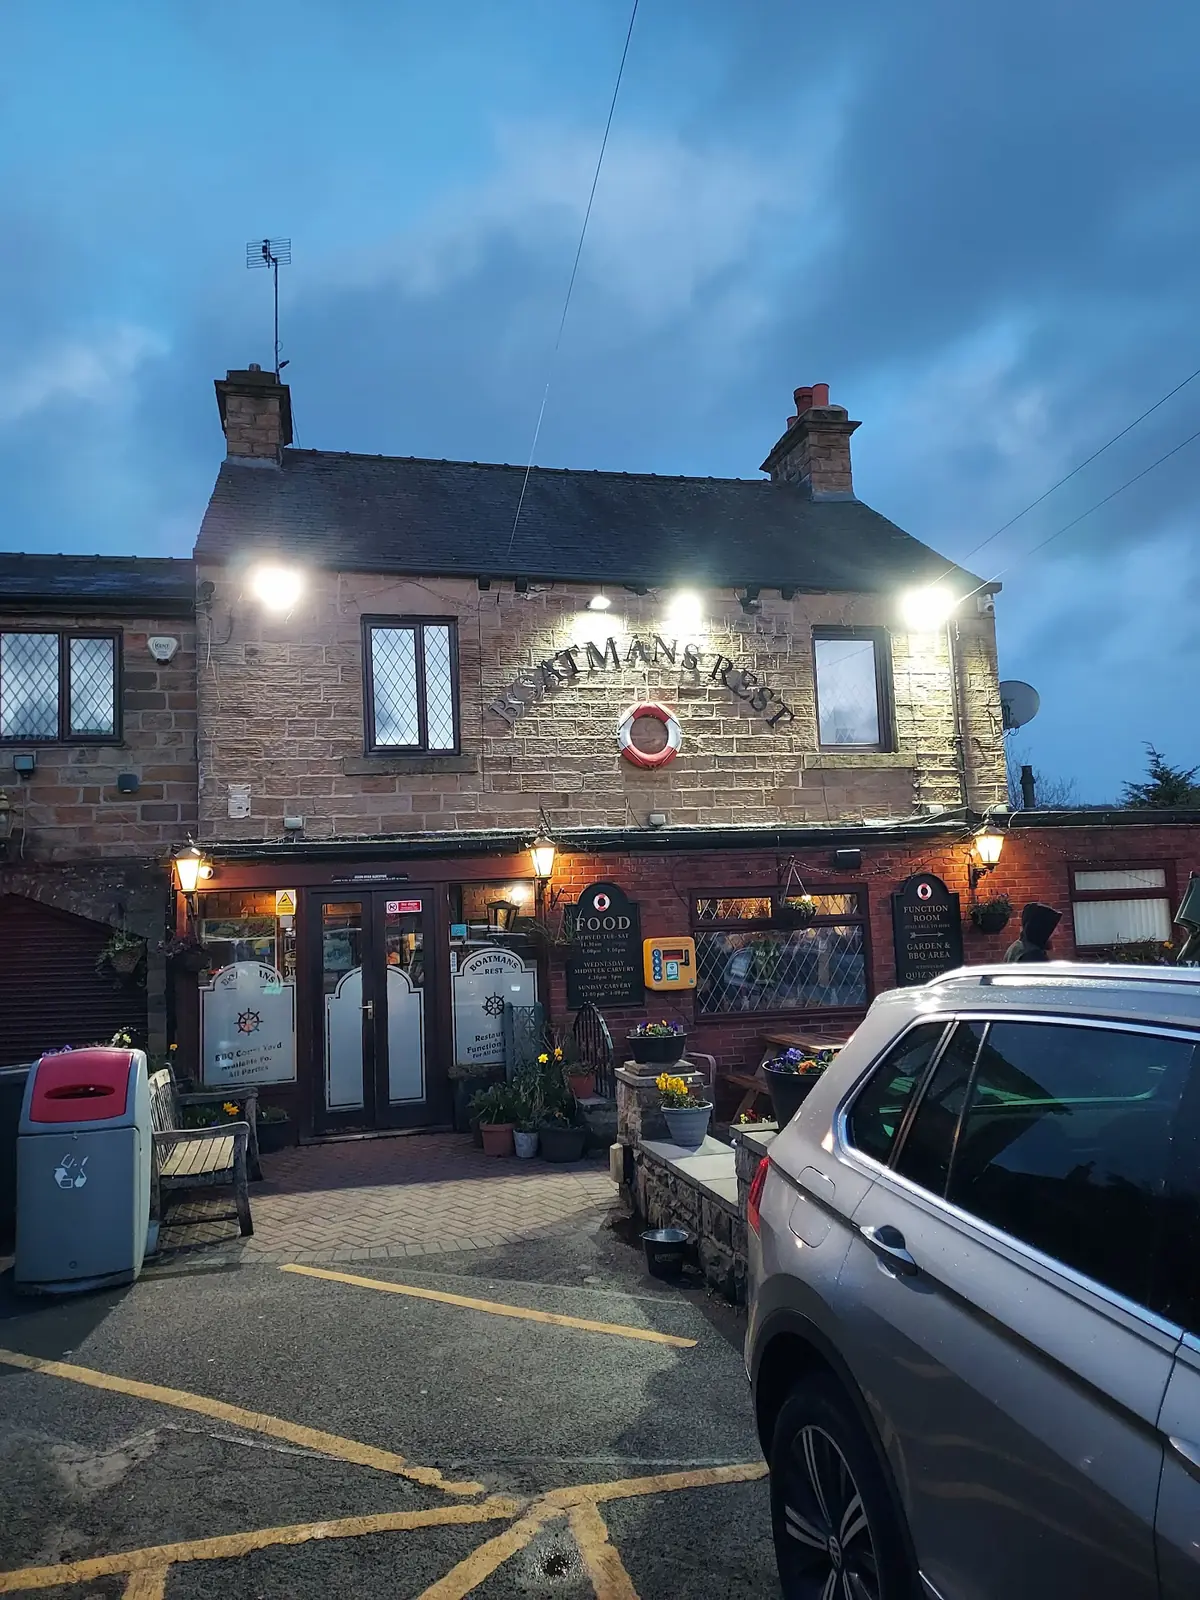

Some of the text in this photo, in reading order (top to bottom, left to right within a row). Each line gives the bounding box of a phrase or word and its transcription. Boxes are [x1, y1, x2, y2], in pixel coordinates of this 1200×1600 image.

[487, 635, 796, 729] BOATMANS REST
[903, 905, 948, 913] FUNCTION
[913, 914, 940, 922] ROOM
[575, 916, 631, 931] FOOD
[907, 942, 942, 950] GARDEN
[908, 951, 950, 960] BBQ AREA
[469, 956, 519, 972] BOATMANS
[583, 960, 625, 968] WEDNESDAY
[905, 971, 927, 981] QUIZ
[475, 1031, 505, 1042] Restaur
[466, 1042, 502, 1054] Function
